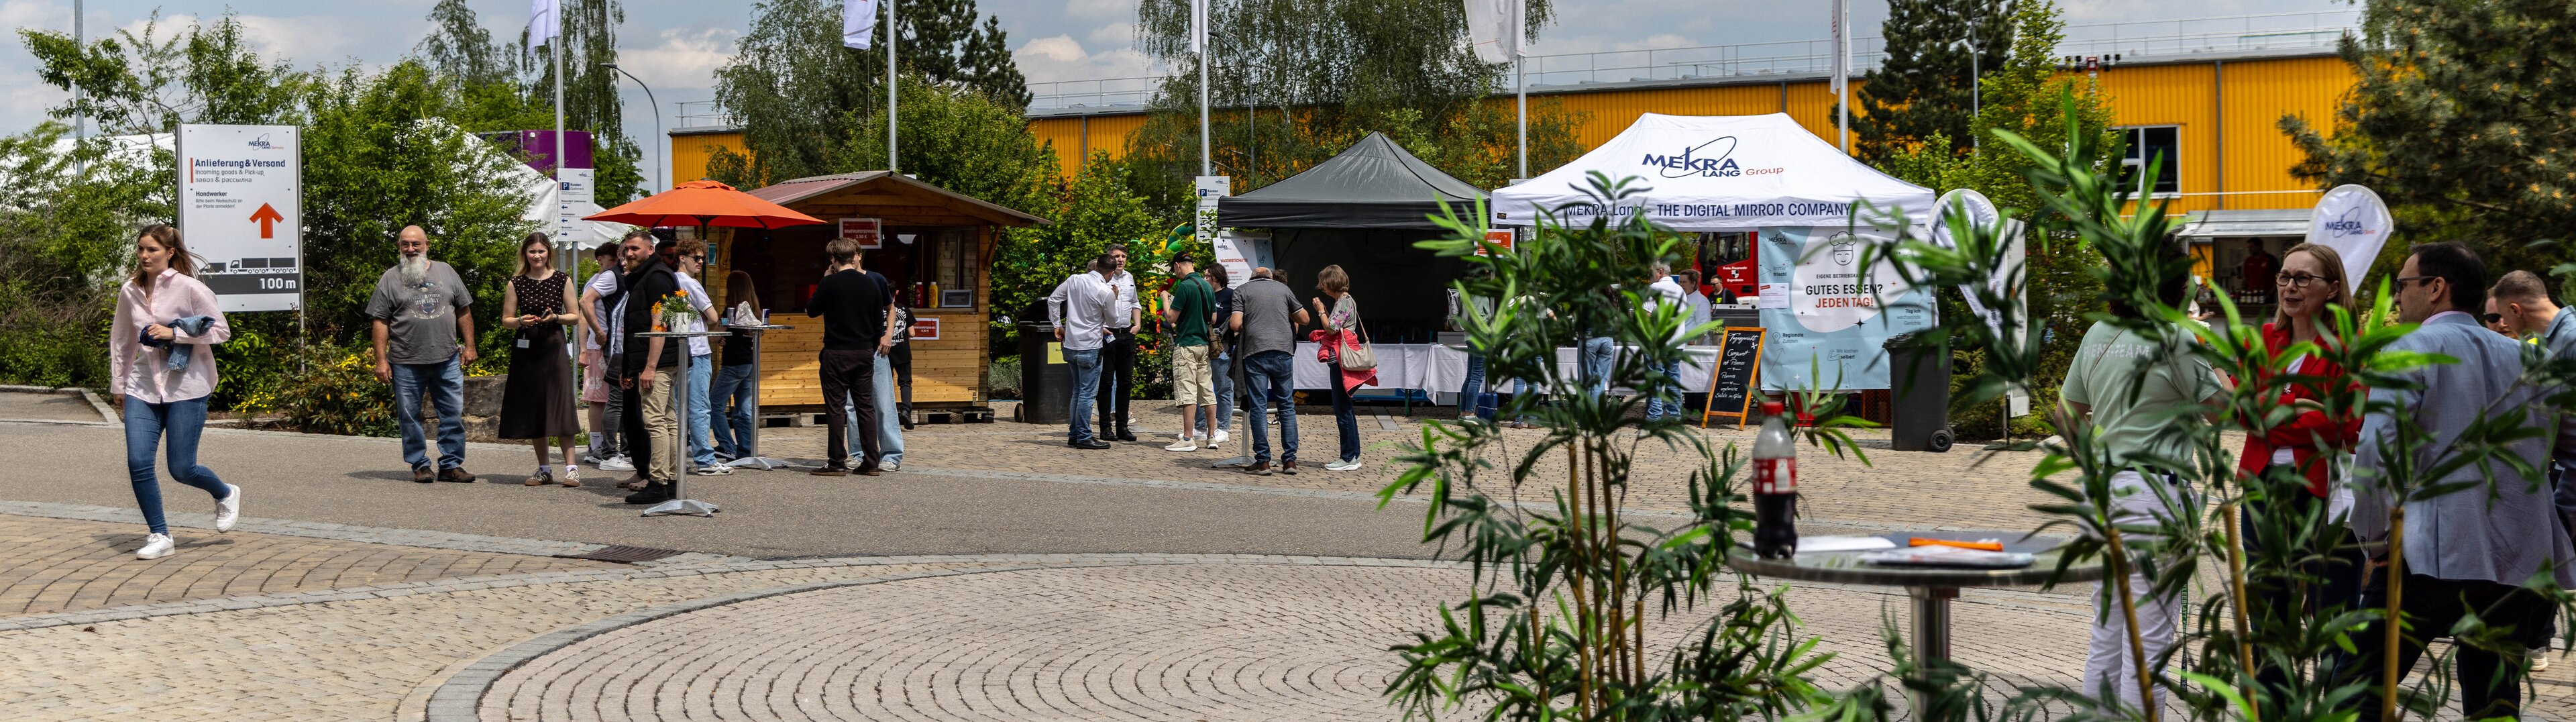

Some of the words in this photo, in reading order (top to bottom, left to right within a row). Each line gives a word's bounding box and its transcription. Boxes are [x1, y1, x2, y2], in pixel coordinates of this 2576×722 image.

[248, 137, 270, 146] MEKRA
[1642, 146, 1739, 171] MEKRA
[1746, 167, 1784, 176] Group
[1566, 203, 1608, 215] MEKRA
[1657, 204, 1679, 217] THE
[1684, 204, 1730, 217] DIGITAL
[1735, 204, 1784, 216] MIRROR
[1788, 203, 1851, 216] COMPANY
[2324, 215, 2363, 230] MEKRA
[1768, 234, 1787, 242] MEKRA
[260, 278, 283, 289] 100
[286, 280, 296, 289] m
[1806, 285, 1839, 295] GUTES
[1843, 284, 1883, 295] ESSEN?
[1815, 298, 1849, 308] JEDEN
[1851, 297, 1874, 307] TAG!
